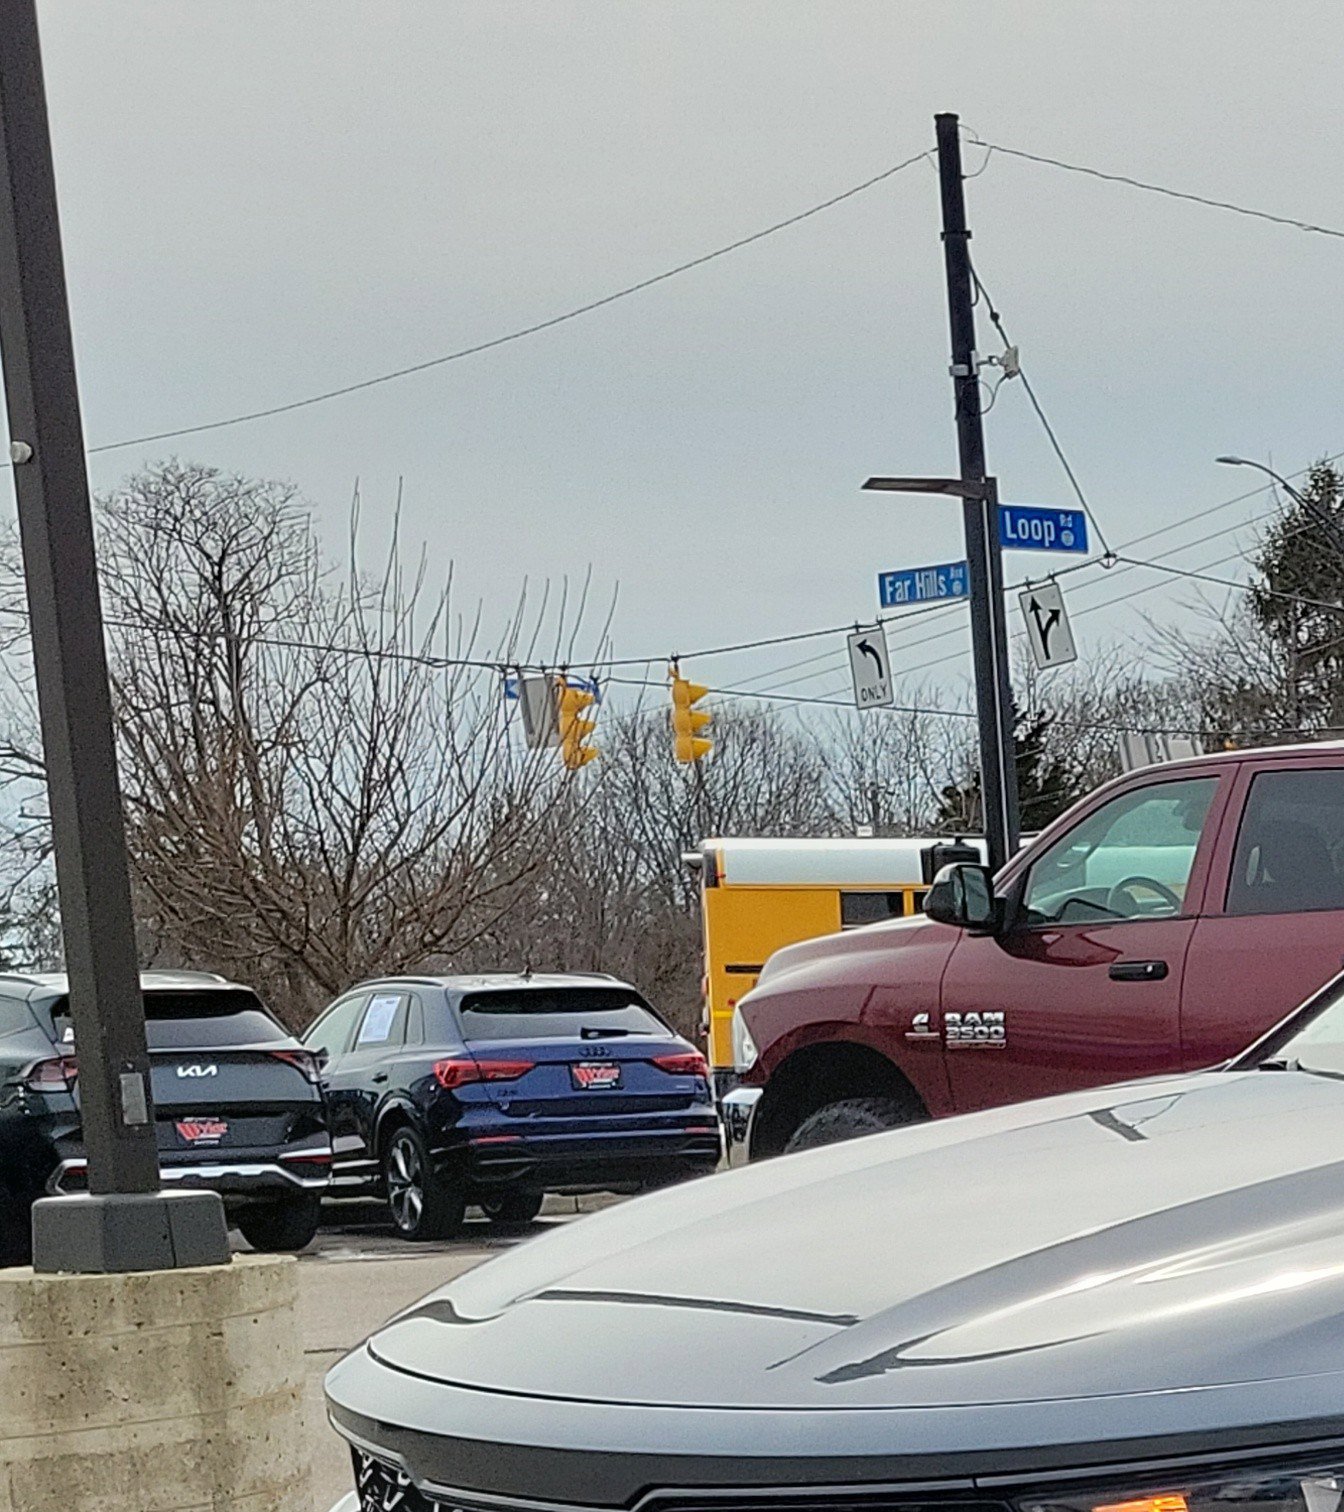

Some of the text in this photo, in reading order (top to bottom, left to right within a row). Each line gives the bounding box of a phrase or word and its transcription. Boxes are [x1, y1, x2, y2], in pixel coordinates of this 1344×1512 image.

[1004, 510, 1055, 547] Loop
[885, 576, 911, 604] Far
[915, 570, 946, 600] Hills
[944, 1012, 1005, 1026] RAM
